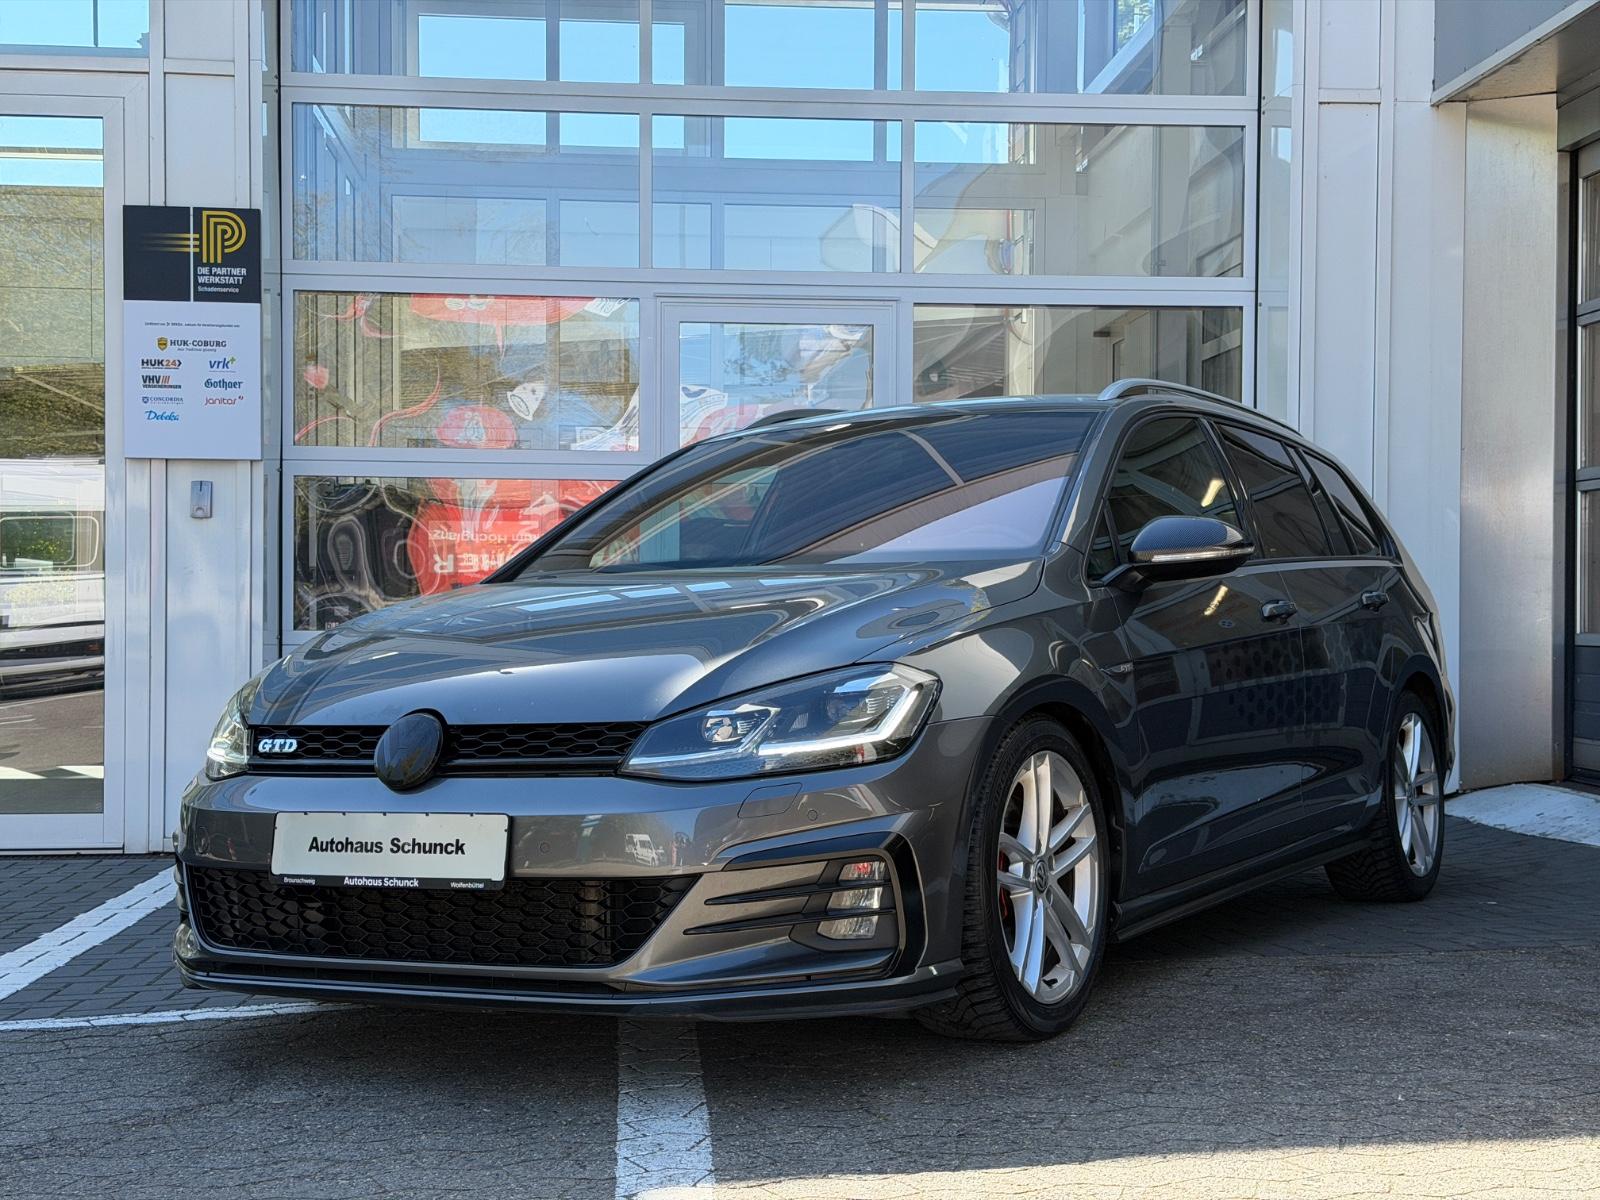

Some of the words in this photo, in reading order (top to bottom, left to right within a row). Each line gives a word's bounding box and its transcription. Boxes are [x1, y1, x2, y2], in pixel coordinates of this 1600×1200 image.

[197, 267, 210, 275] DIE
[211, 267, 247, 276] PARTNER
[197, 276, 244, 285] WERKSTATT
[169, 339, 227, 348] HUK-COBURG
[141, 359, 177, 367] HUK24
[208, 357, 230, 369] vrk
[141, 375, 161, 384] VHV
[204, 378, 244, 390] Gothaer
[258, 738, 298, 753] GTD
[308, 836, 384, 853] Autohaus
[389, 837, 466, 855] Schunck
[343, 876, 383, 887] Autohaus
[383, 877, 419, 888] Schunck
